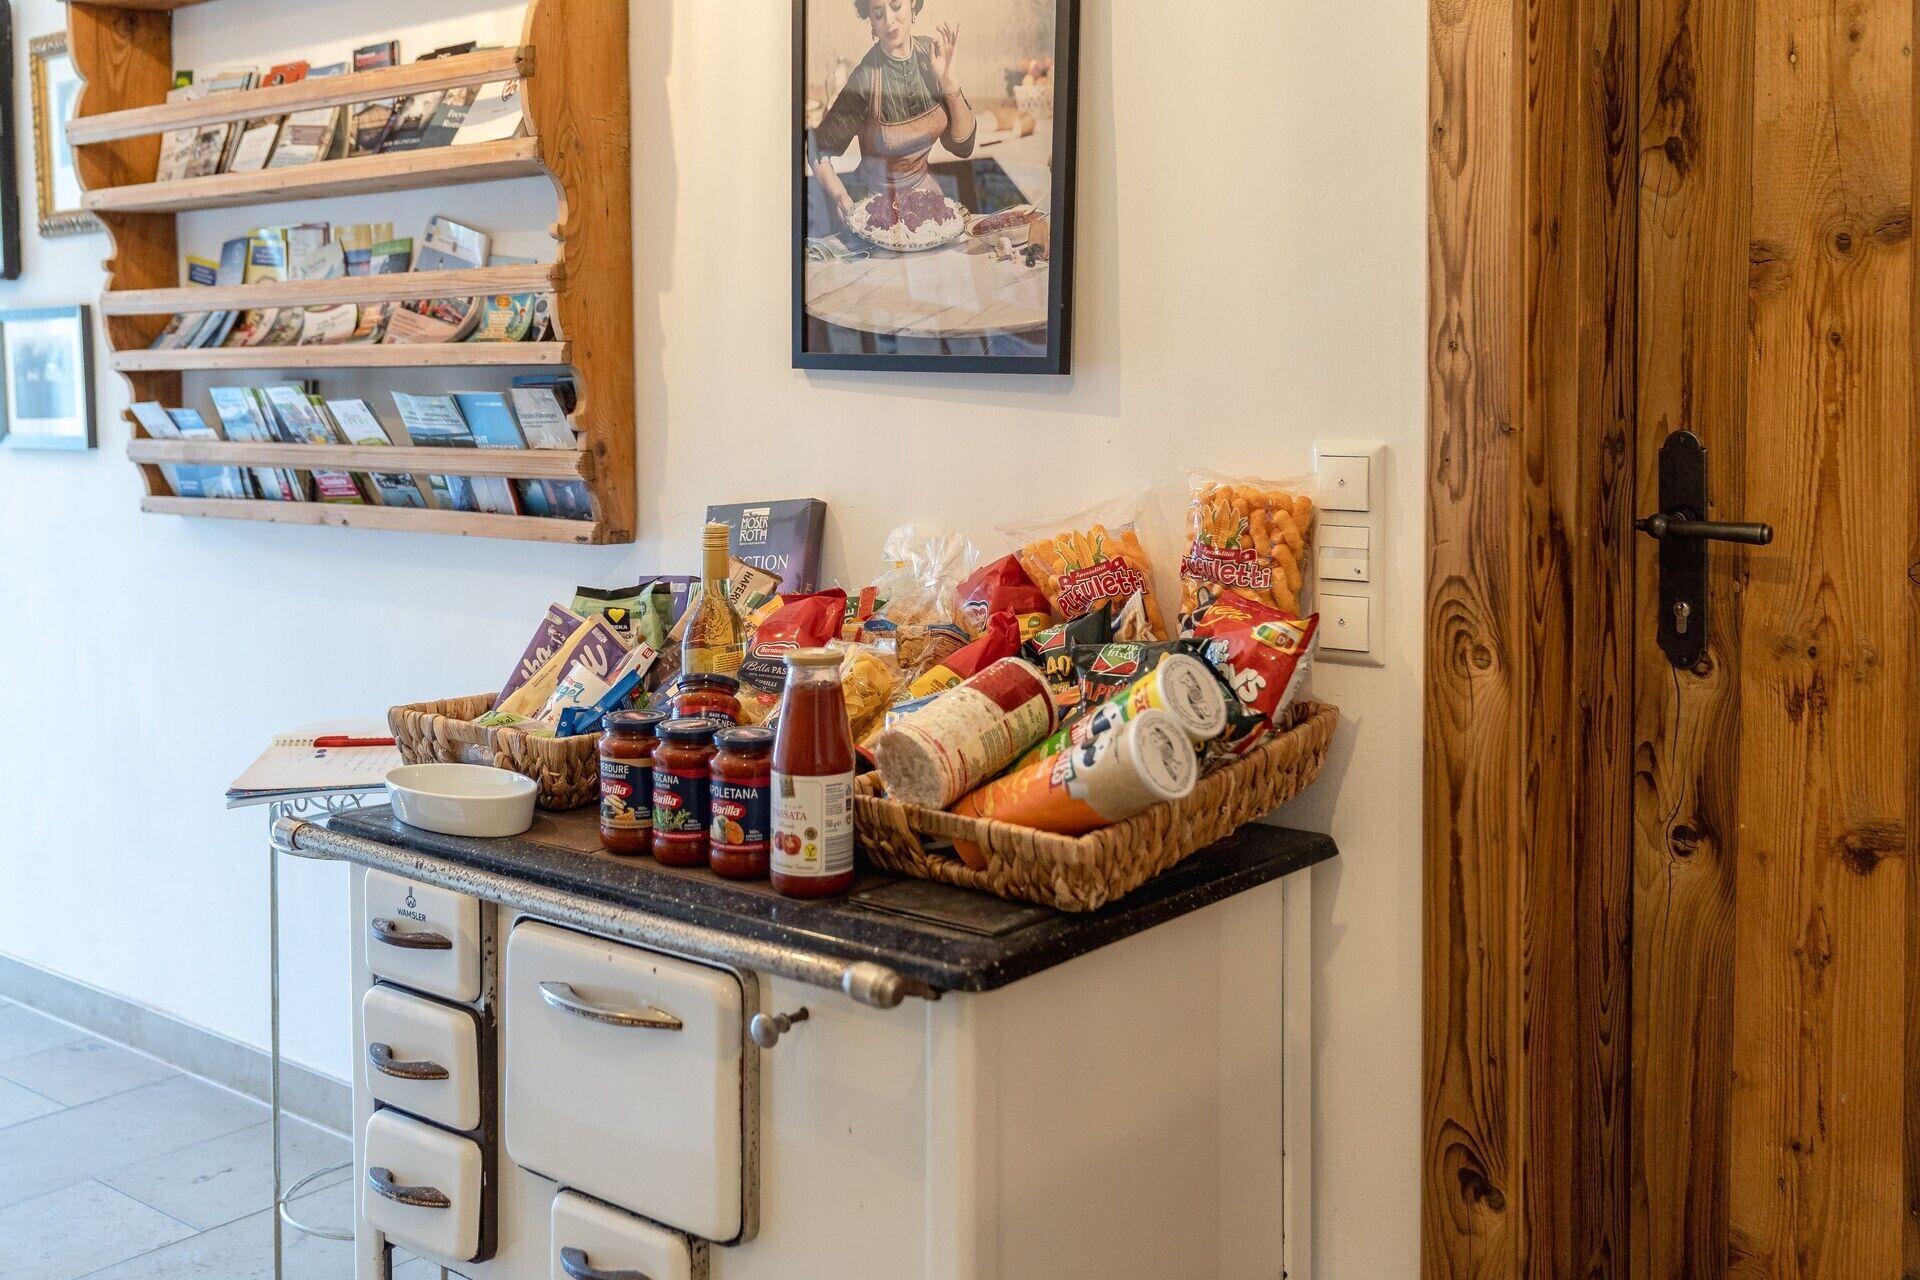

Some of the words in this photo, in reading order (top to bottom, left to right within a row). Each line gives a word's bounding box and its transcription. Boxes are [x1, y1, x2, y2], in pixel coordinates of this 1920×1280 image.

[741, 516, 769, 529] MOSER
[739, 528, 767, 541] ROTH
[739, 554, 789, 571] CTION
[743, 660, 770, 673] Bella
[755, 678, 778, 688] FUSILLI
[601, 762, 630, 775] ERDURE
[601, 782, 627, 796] Barilla
[710, 783, 759, 800] POLETANA
[653, 791, 678, 806] Barilla
[712, 802, 741, 817] Barilla
[397, 907, 427, 922] WAMSLER
